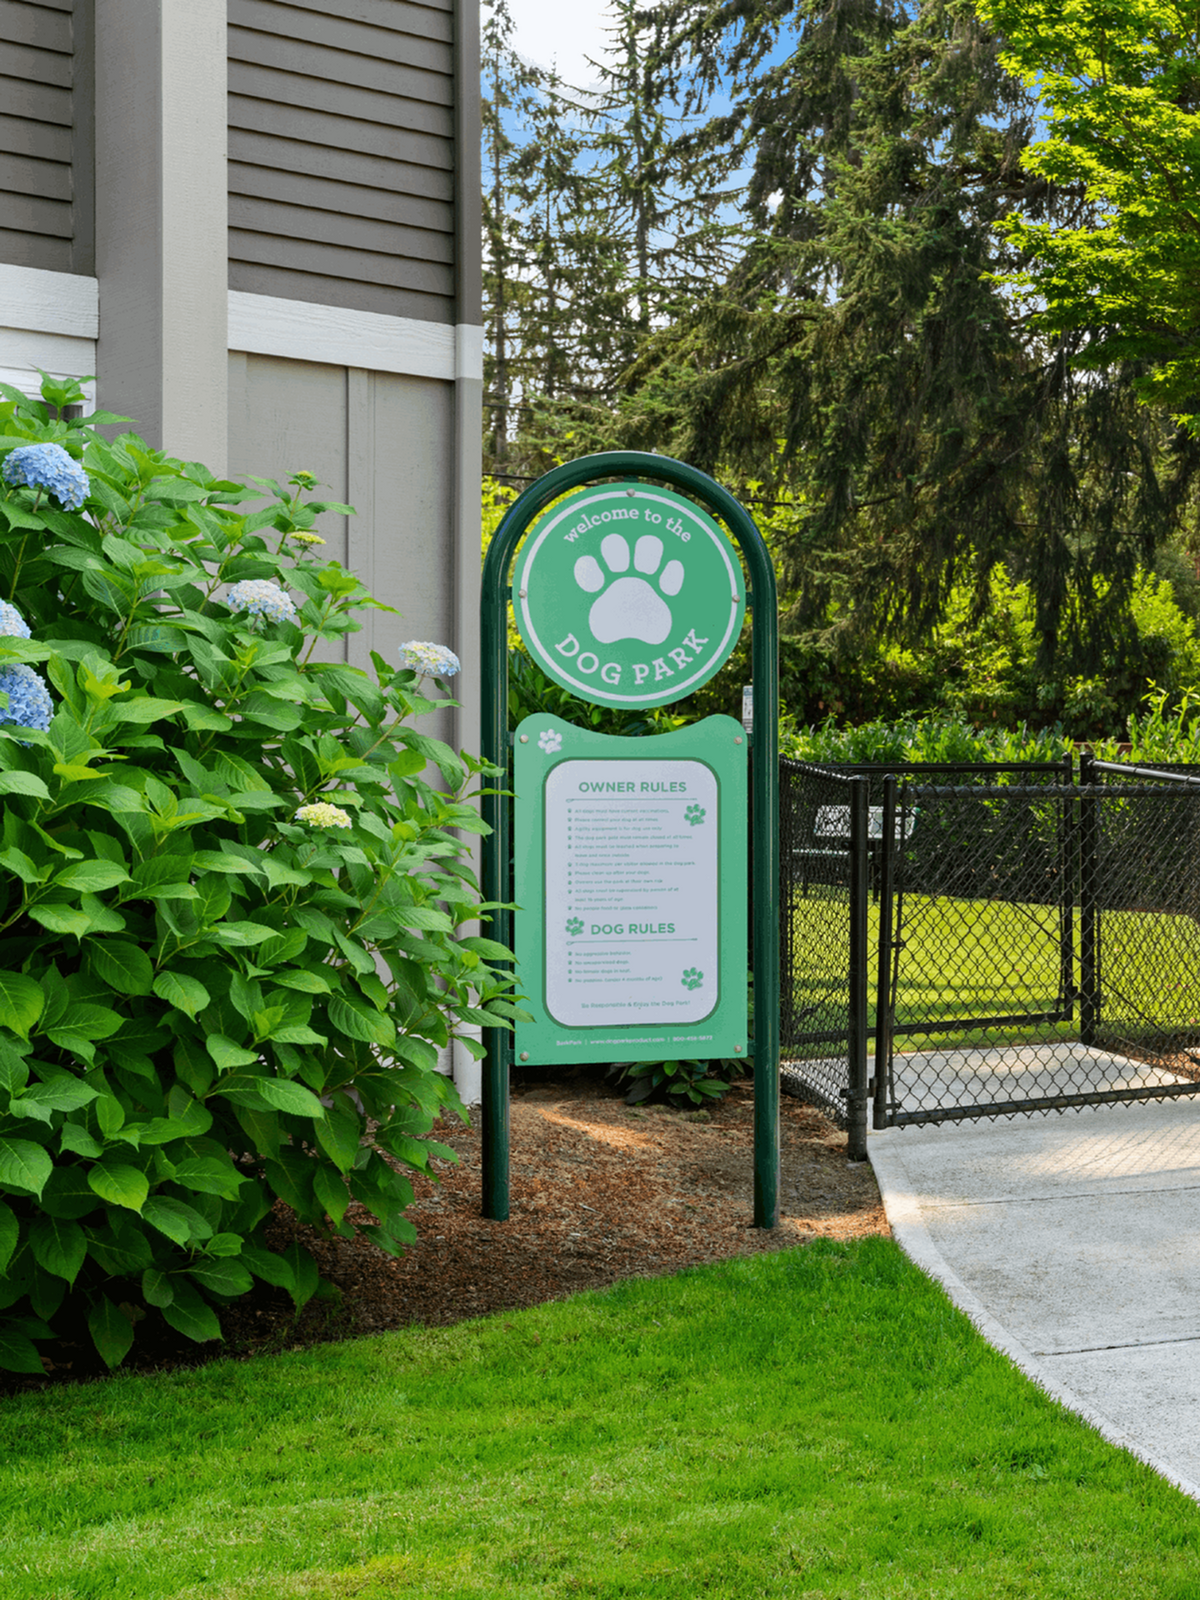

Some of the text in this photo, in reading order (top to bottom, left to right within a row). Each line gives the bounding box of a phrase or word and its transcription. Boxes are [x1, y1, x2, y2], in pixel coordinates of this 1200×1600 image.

[563, 508, 692, 544] welcome to the
[554, 628, 709, 685] DOG PARK
[578, 781, 687, 793] OWNER RULES
[590, 922, 676, 936] DOG RULES
